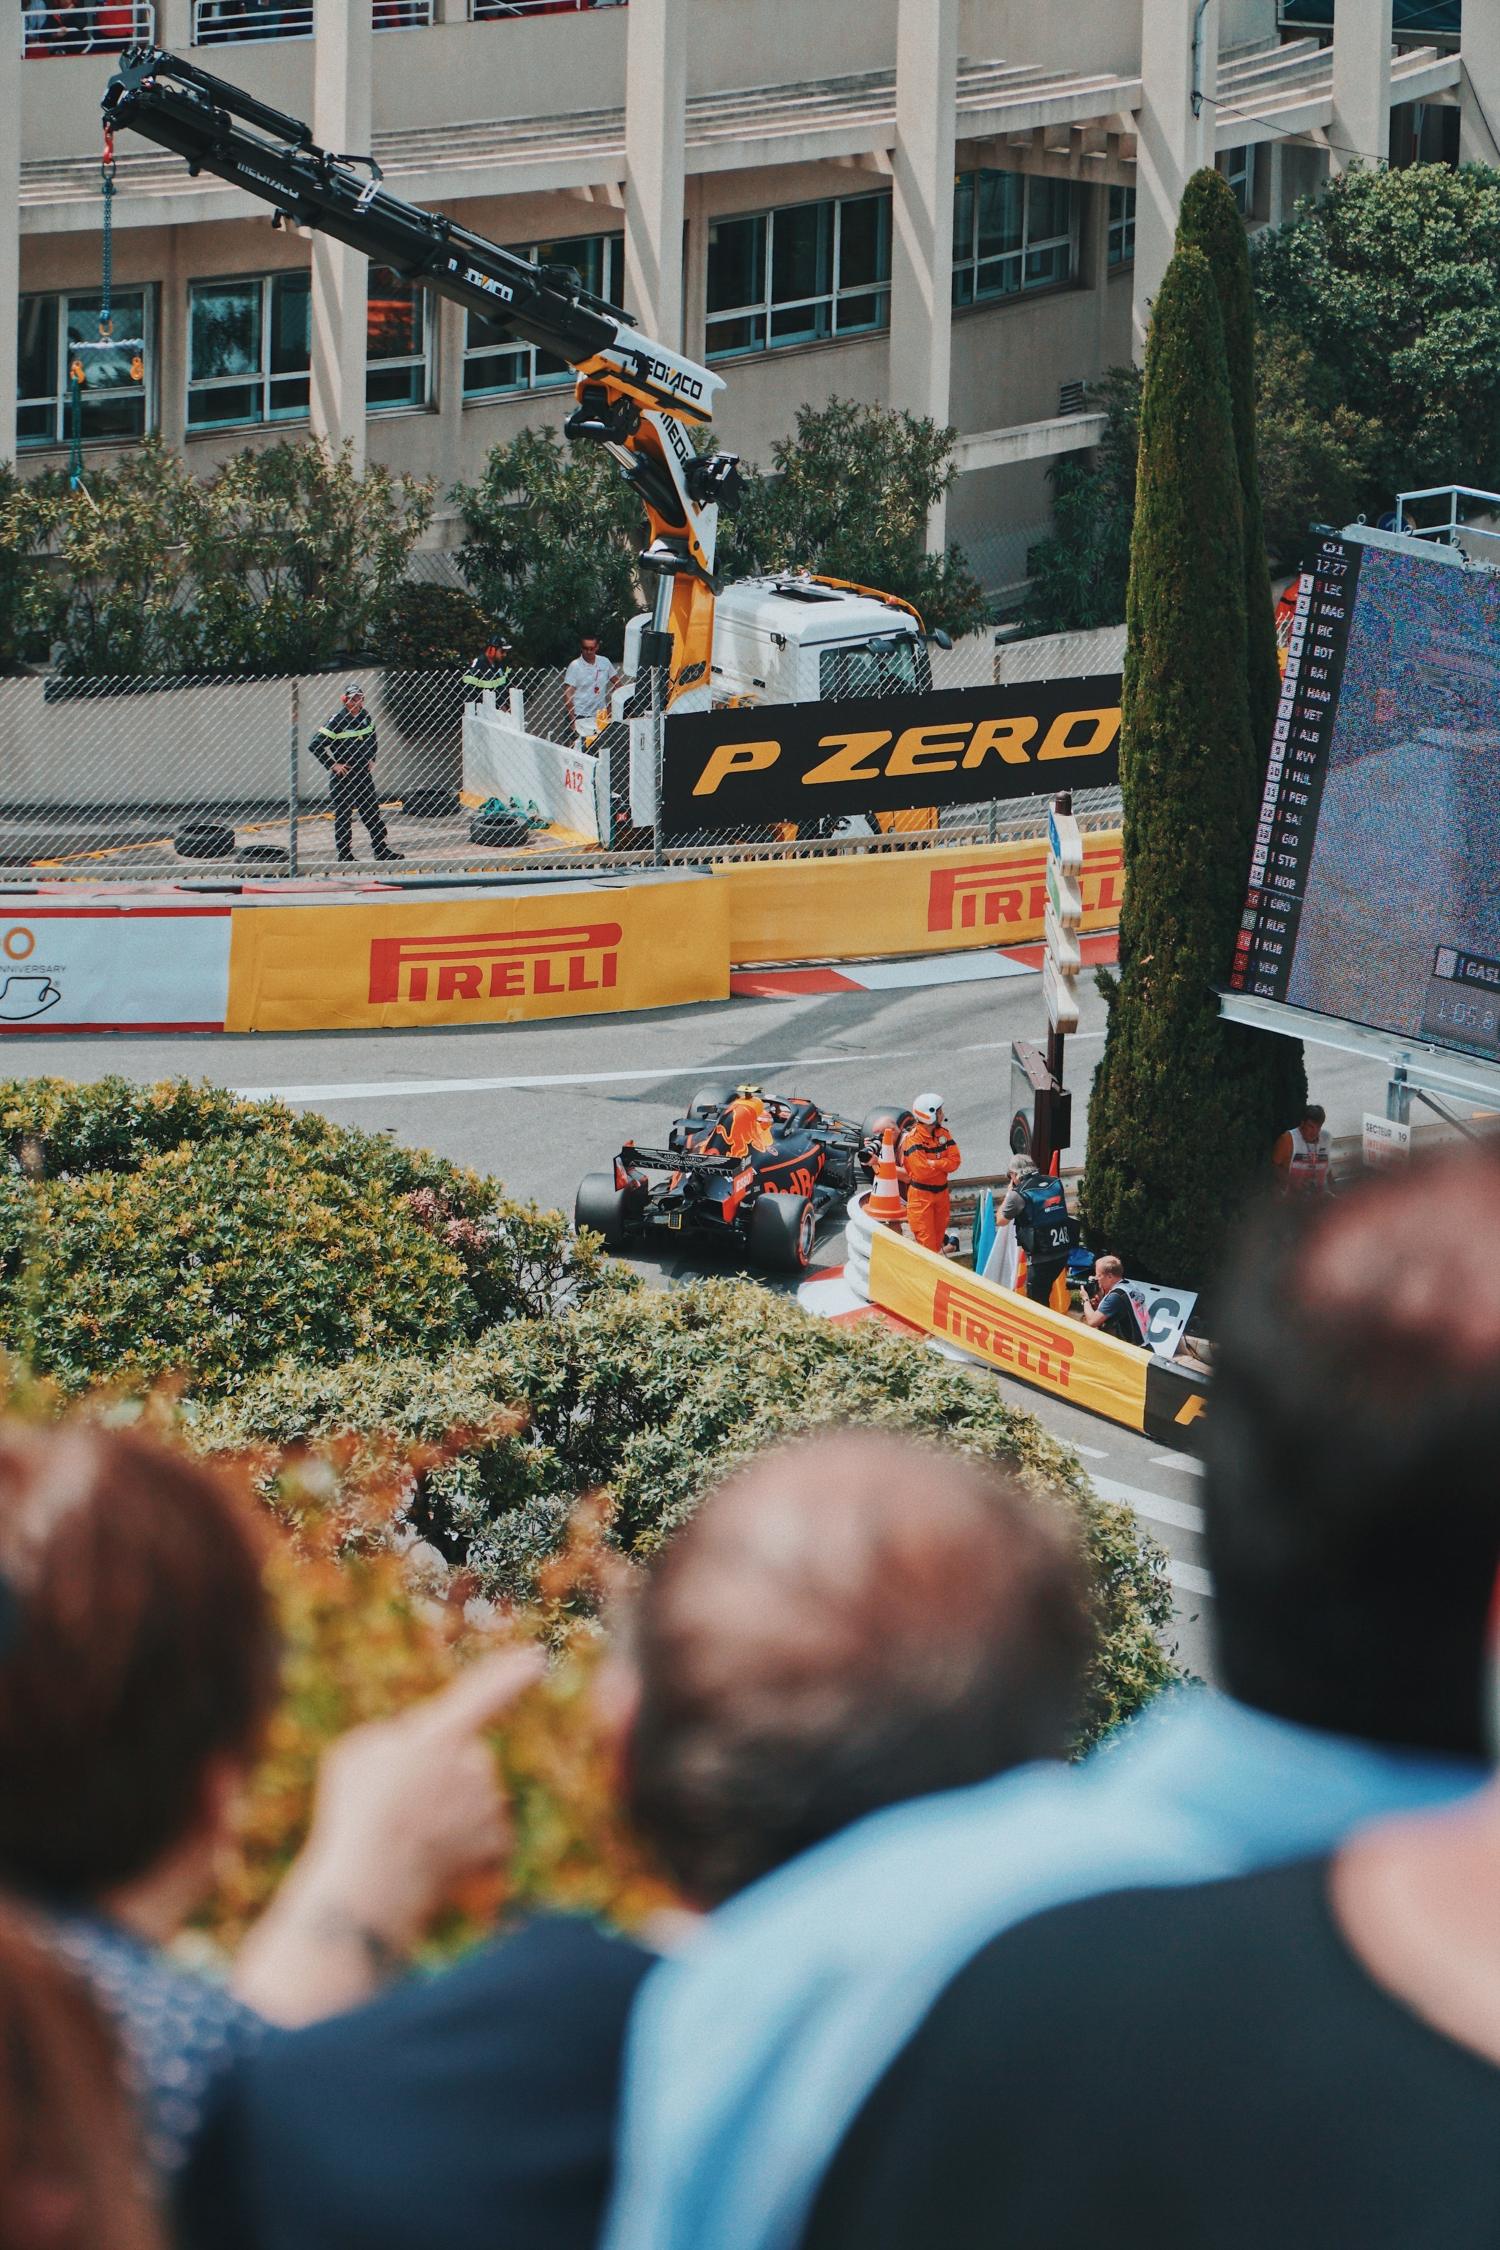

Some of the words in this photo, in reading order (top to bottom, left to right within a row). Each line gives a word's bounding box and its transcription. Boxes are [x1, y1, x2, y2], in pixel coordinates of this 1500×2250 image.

[565, 769, 583, 793] A12
[692, 741, 781, 796] P
[801, 707, 1121, 785] ZERO
[368, 922, 622, 1004] PIRELLI
[1050, 1226, 1070, 1247] 248
[933, 1279, 1075, 1387] PIRELLI
